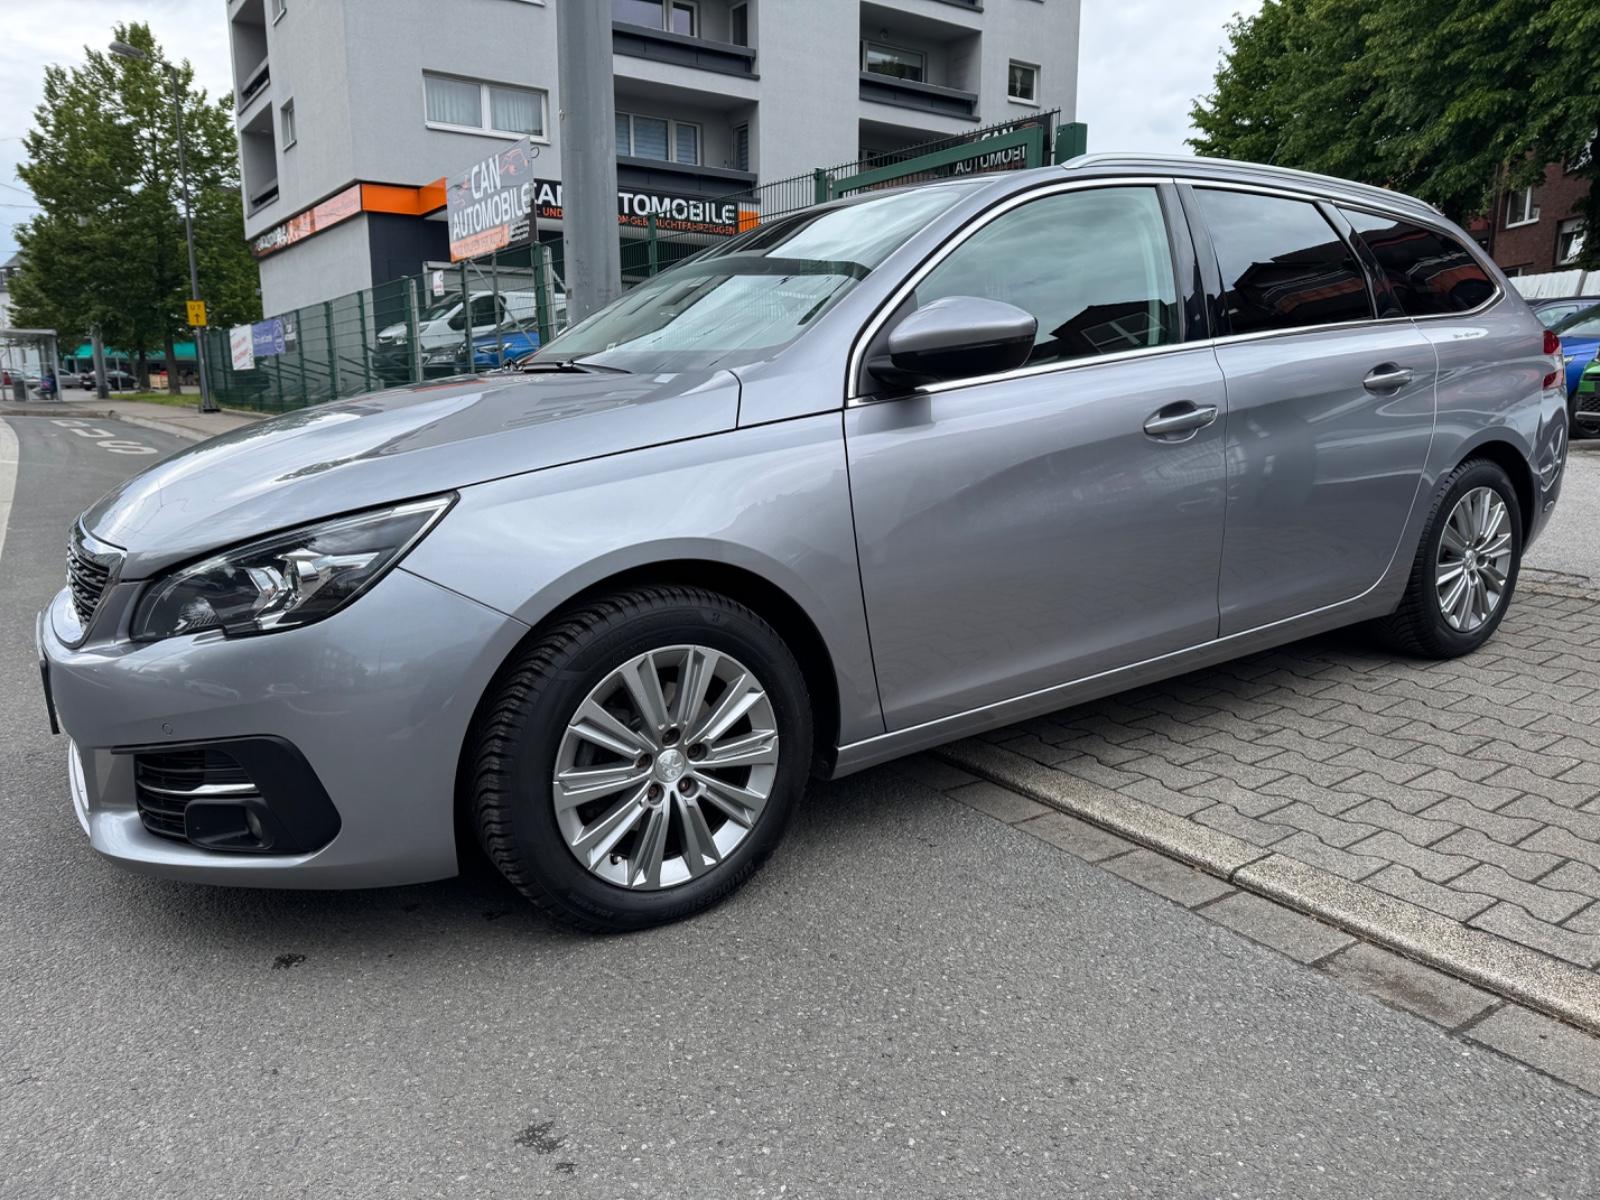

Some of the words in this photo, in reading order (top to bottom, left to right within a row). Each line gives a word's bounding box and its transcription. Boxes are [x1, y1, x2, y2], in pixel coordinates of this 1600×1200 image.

[471, 154, 501, 199] CAN
[954, 146, 1026, 175] AUTOMOBI
[453, 182, 532, 240] AUTOMOBILE
[618, 192, 735, 224] TOMOBILE
[630, 215, 736, 235] GEBAUCHTFAHRZEUGEN
